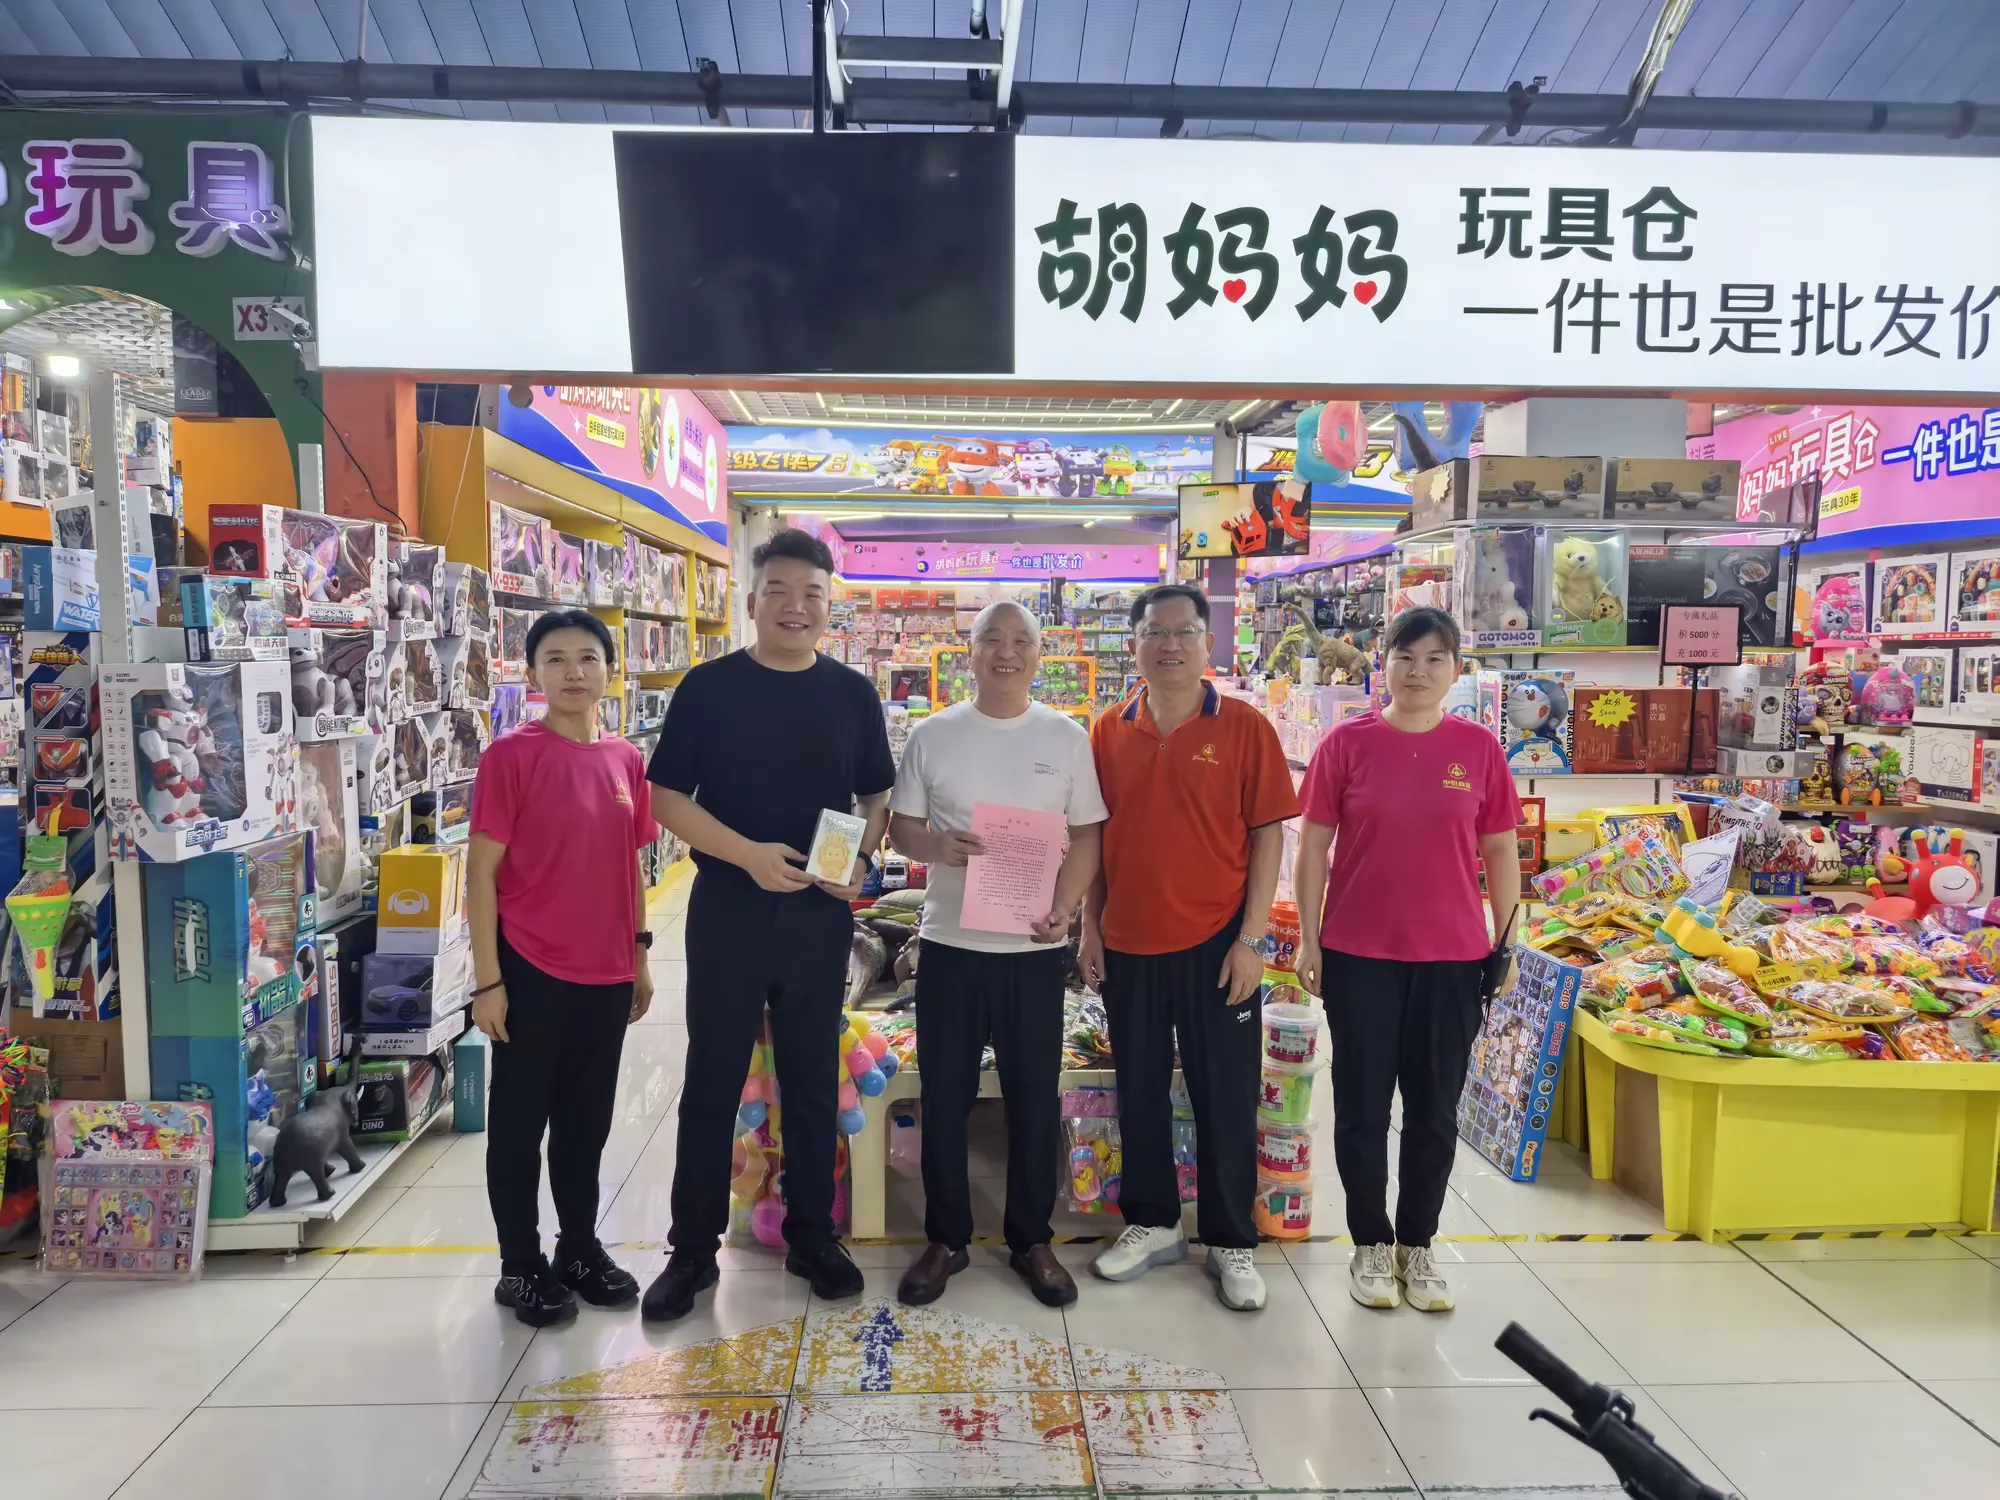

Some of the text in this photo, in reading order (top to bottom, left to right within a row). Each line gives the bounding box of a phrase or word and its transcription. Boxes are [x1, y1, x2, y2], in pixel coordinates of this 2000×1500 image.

[23, 140, 286, 257] 玩具
[1457, 186, 1698, 262] 玩具仓
[1034, 197, 1408, 324] 胡妈妈
[1769, 430, 1788, 445] LIVE
[727, 450, 827, 471] 级飞侠
[493, 572, 520, 592] K-933
[1682, 610, 1719, 621] 专属礼品
[1478, 631, 1537, 642] GOTOMOO
[1679, 629, 1720, 640] 积 5000 分
[1689, 649, 1708, 658] 1000
[1710, 648, 1719, 659] 元
[1559, 976, 1574, 1010] 60PCS
[327, 963, 340, 1056] ROBOTS
[361, 1121, 384, 1131] DINO
